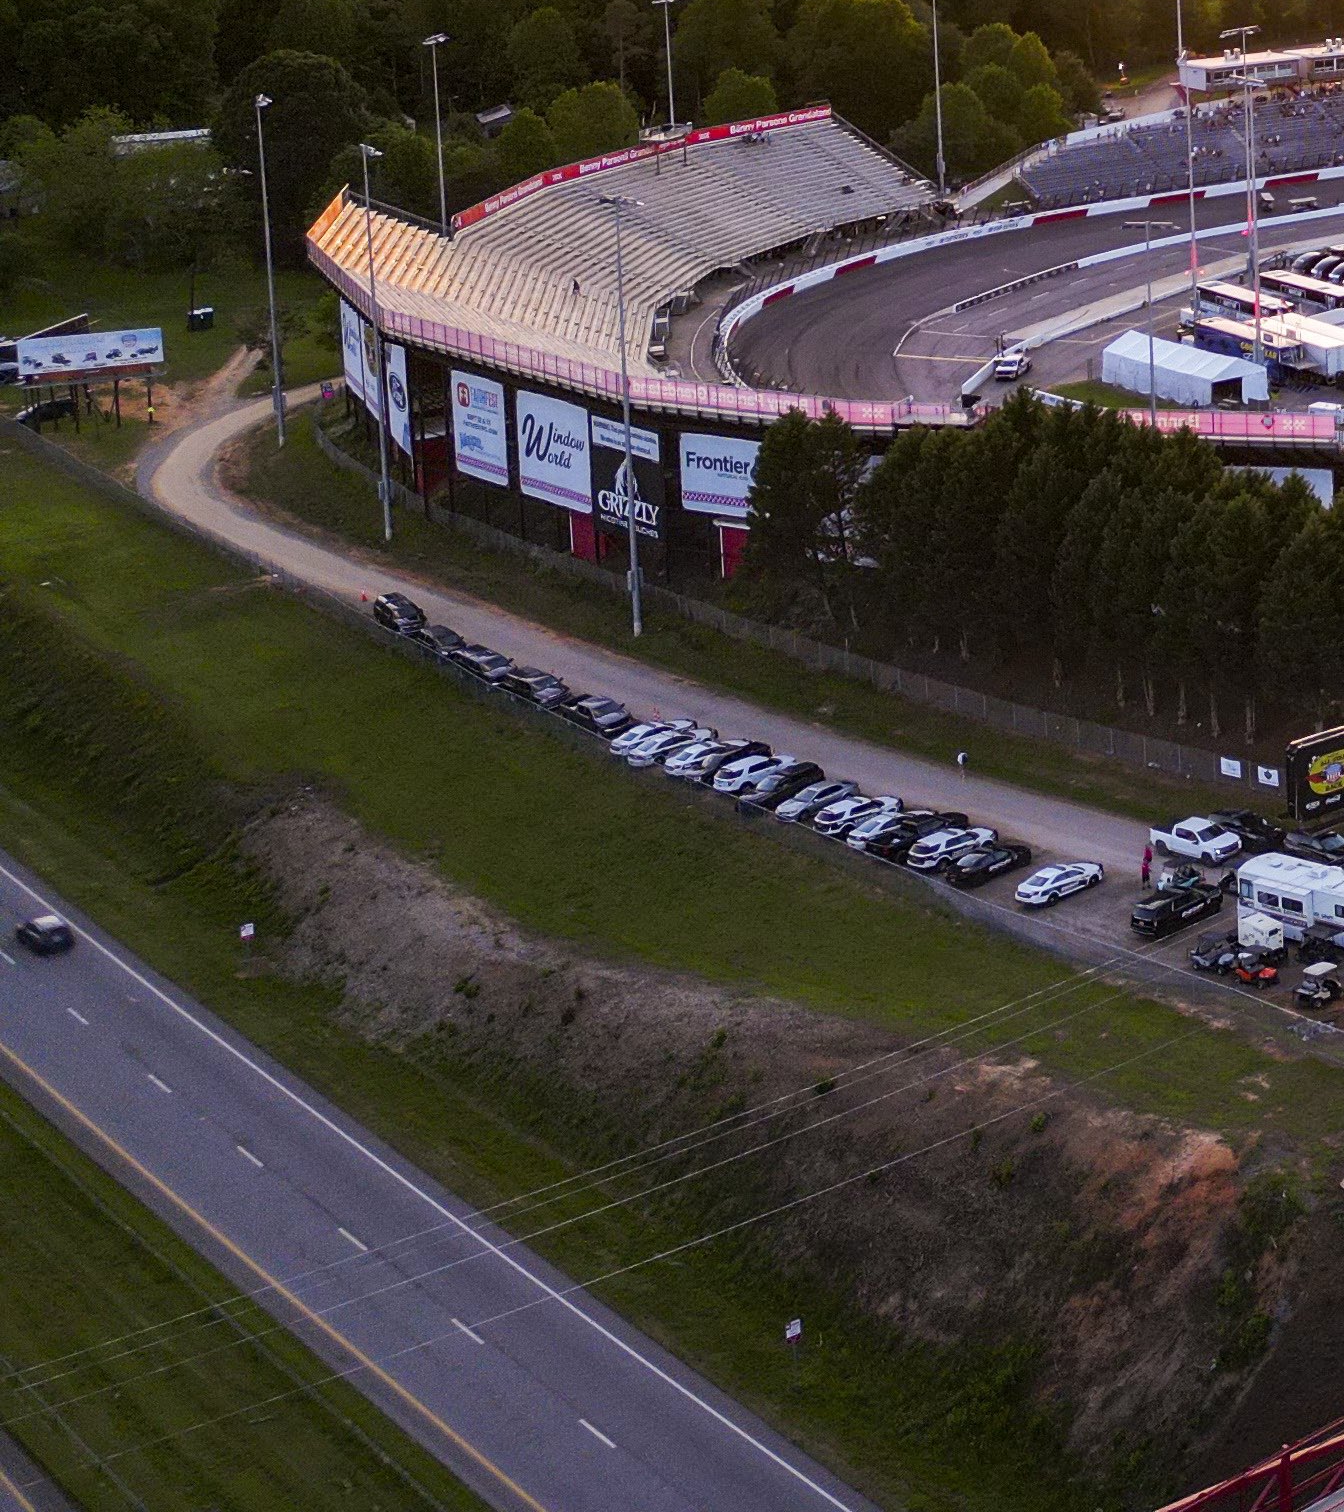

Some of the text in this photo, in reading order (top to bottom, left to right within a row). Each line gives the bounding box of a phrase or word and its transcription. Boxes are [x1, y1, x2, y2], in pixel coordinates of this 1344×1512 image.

[729, 122, 754, 134] Benny
[755, 115, 788, 129] Parsons
[686, 451, 750, 475] Frontier
